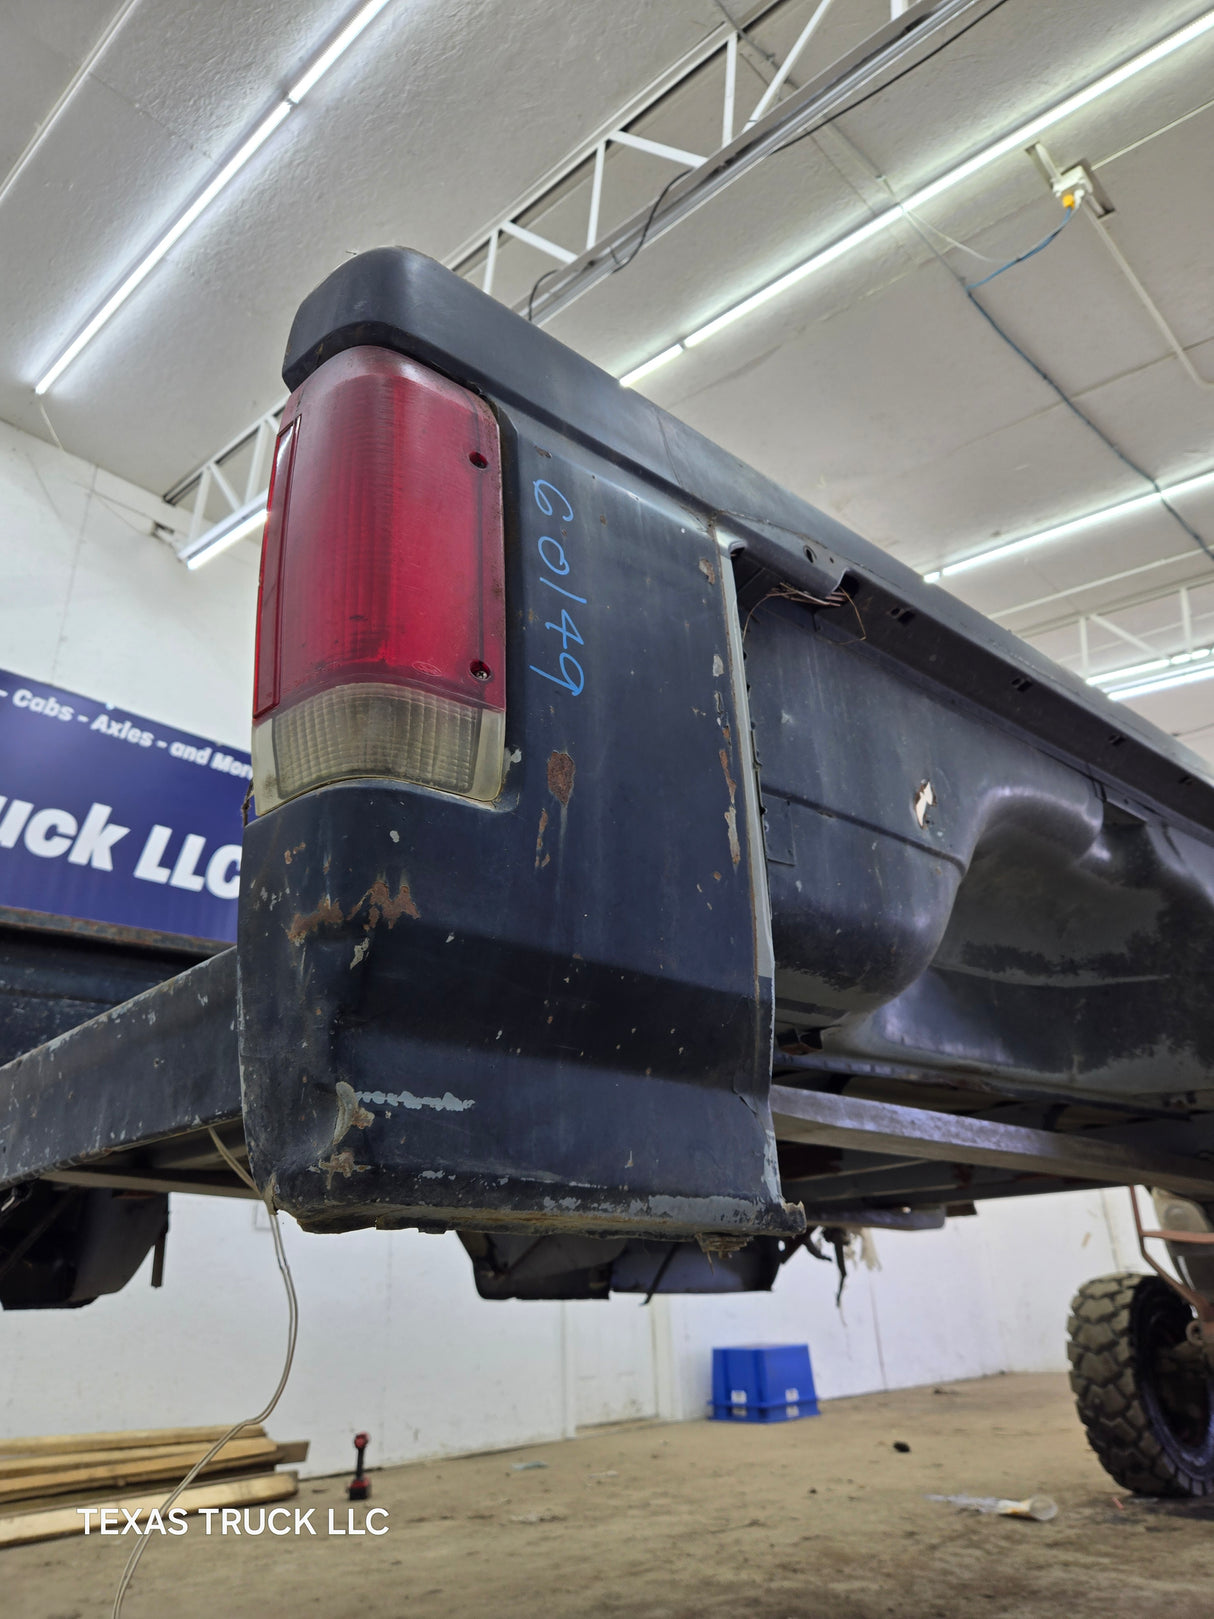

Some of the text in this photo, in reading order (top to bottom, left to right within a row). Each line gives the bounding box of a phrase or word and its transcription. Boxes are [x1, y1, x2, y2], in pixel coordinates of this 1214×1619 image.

[529, 479, 587, 696] 60149
[12, 688, 75, 722] Cabs
[90, 714, 154, 748] Axles
[169, 741, 212, 766] and
[133, 824, 242, 900] LLC
